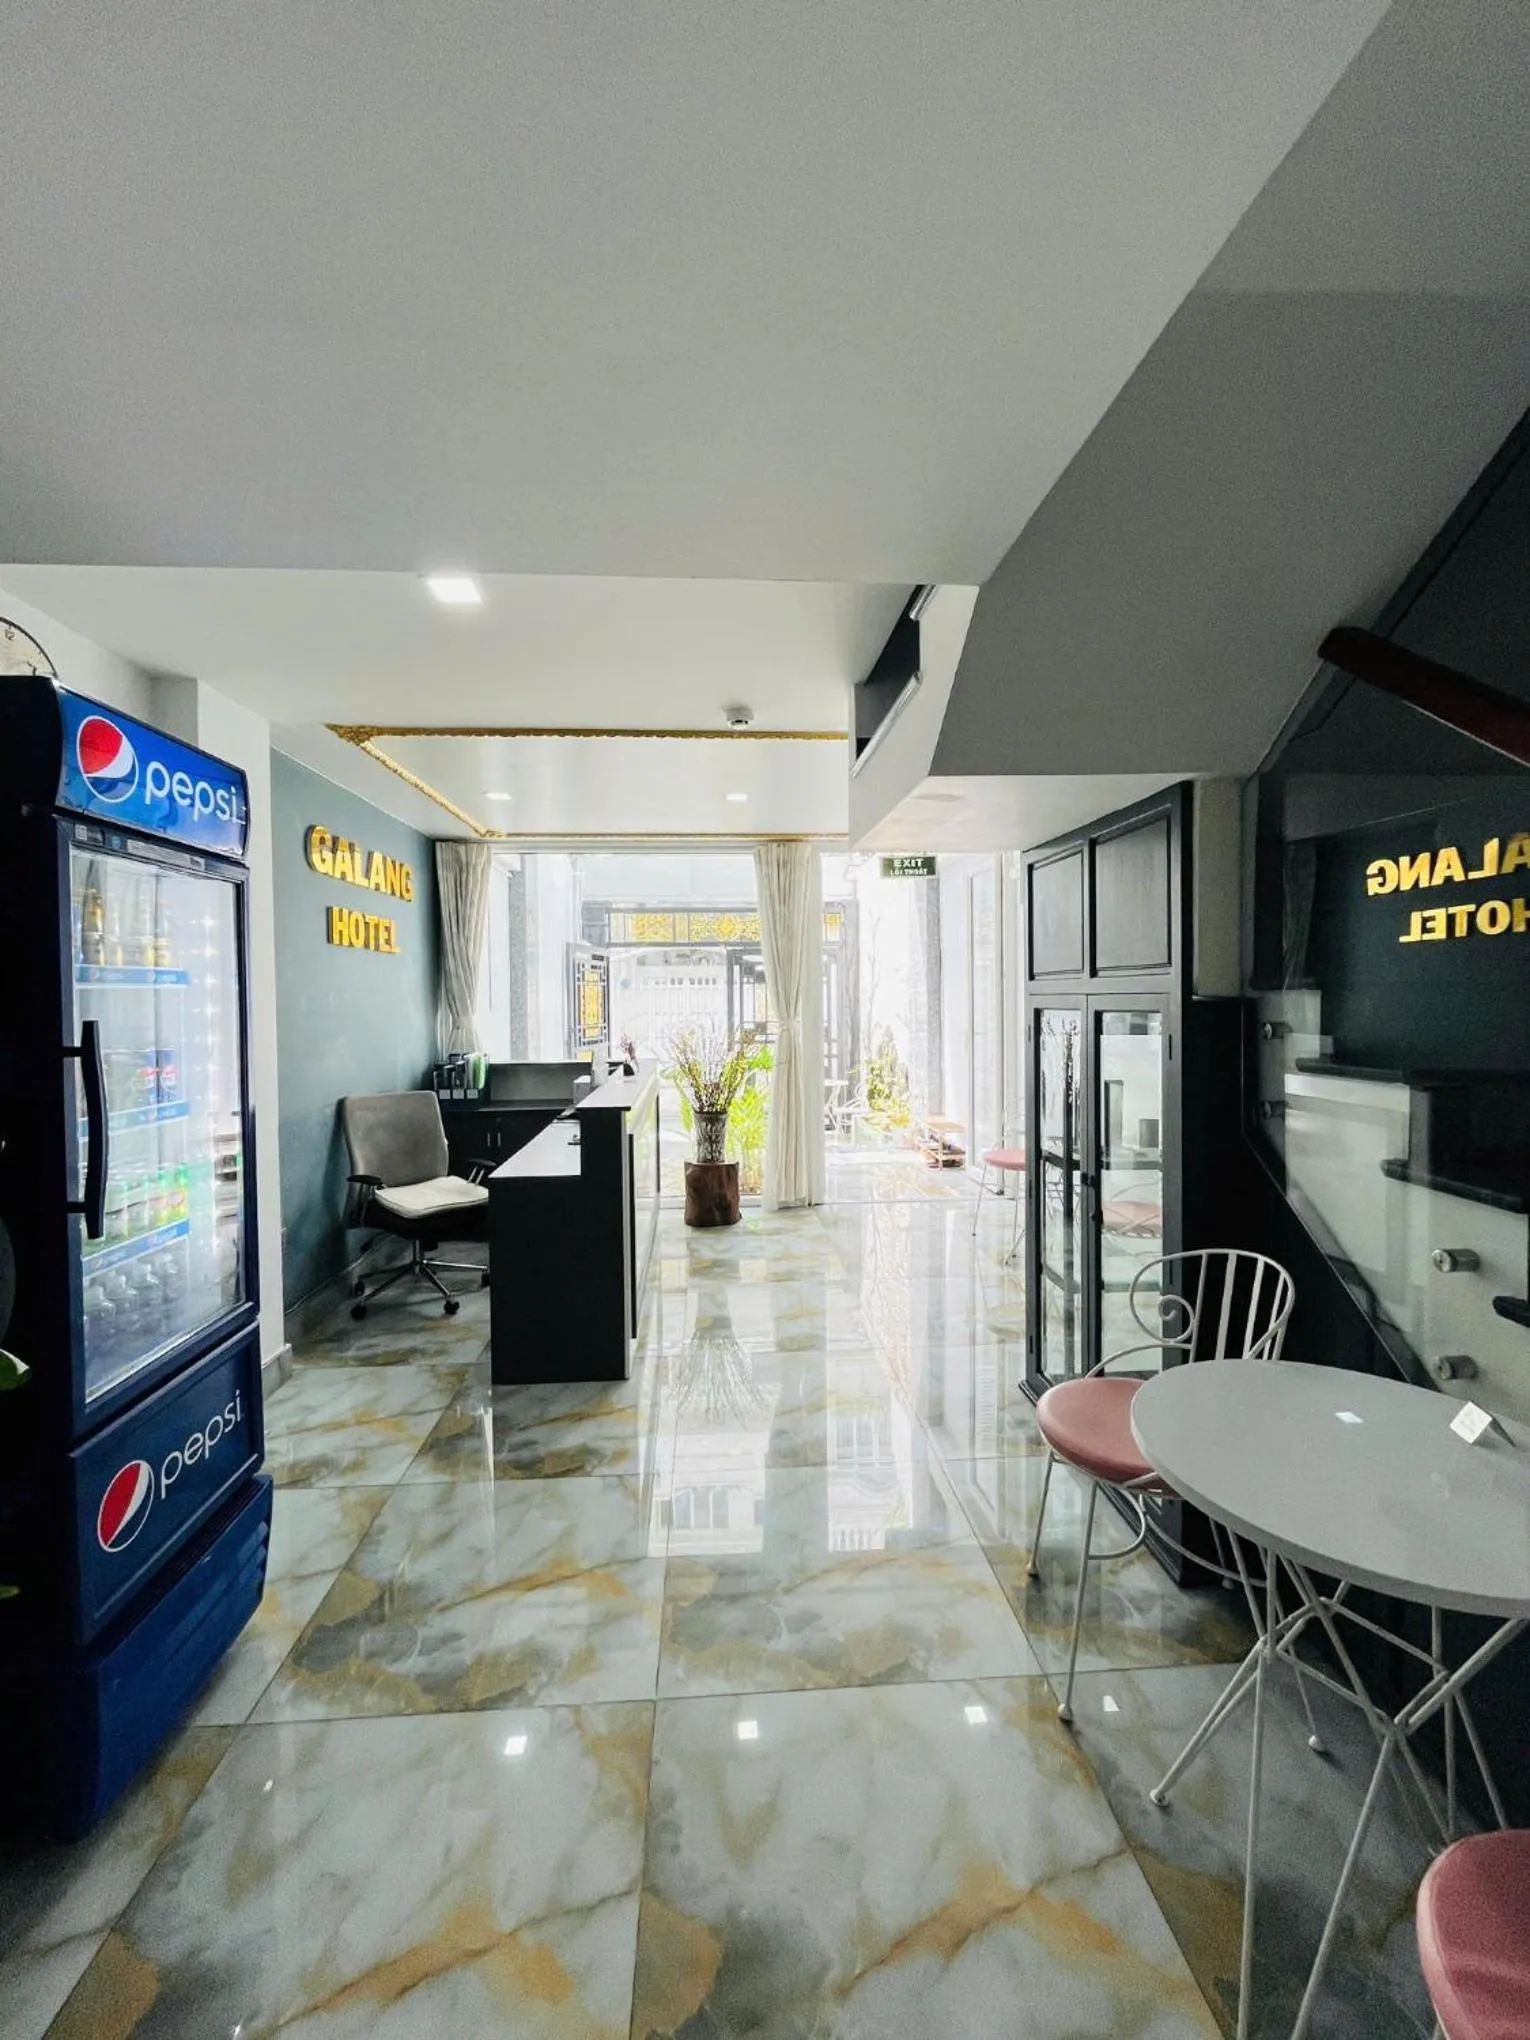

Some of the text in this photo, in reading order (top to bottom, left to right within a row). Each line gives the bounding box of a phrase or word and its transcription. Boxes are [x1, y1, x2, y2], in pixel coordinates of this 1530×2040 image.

[144, 761, 237, 824] pepsi
[304, 824, 414, 902] GALANG
[893, 858, 924, 867] EXIT
[326, 906, 401, 953] HOTEL
[161, 1389, 241, 1500] pepsi
